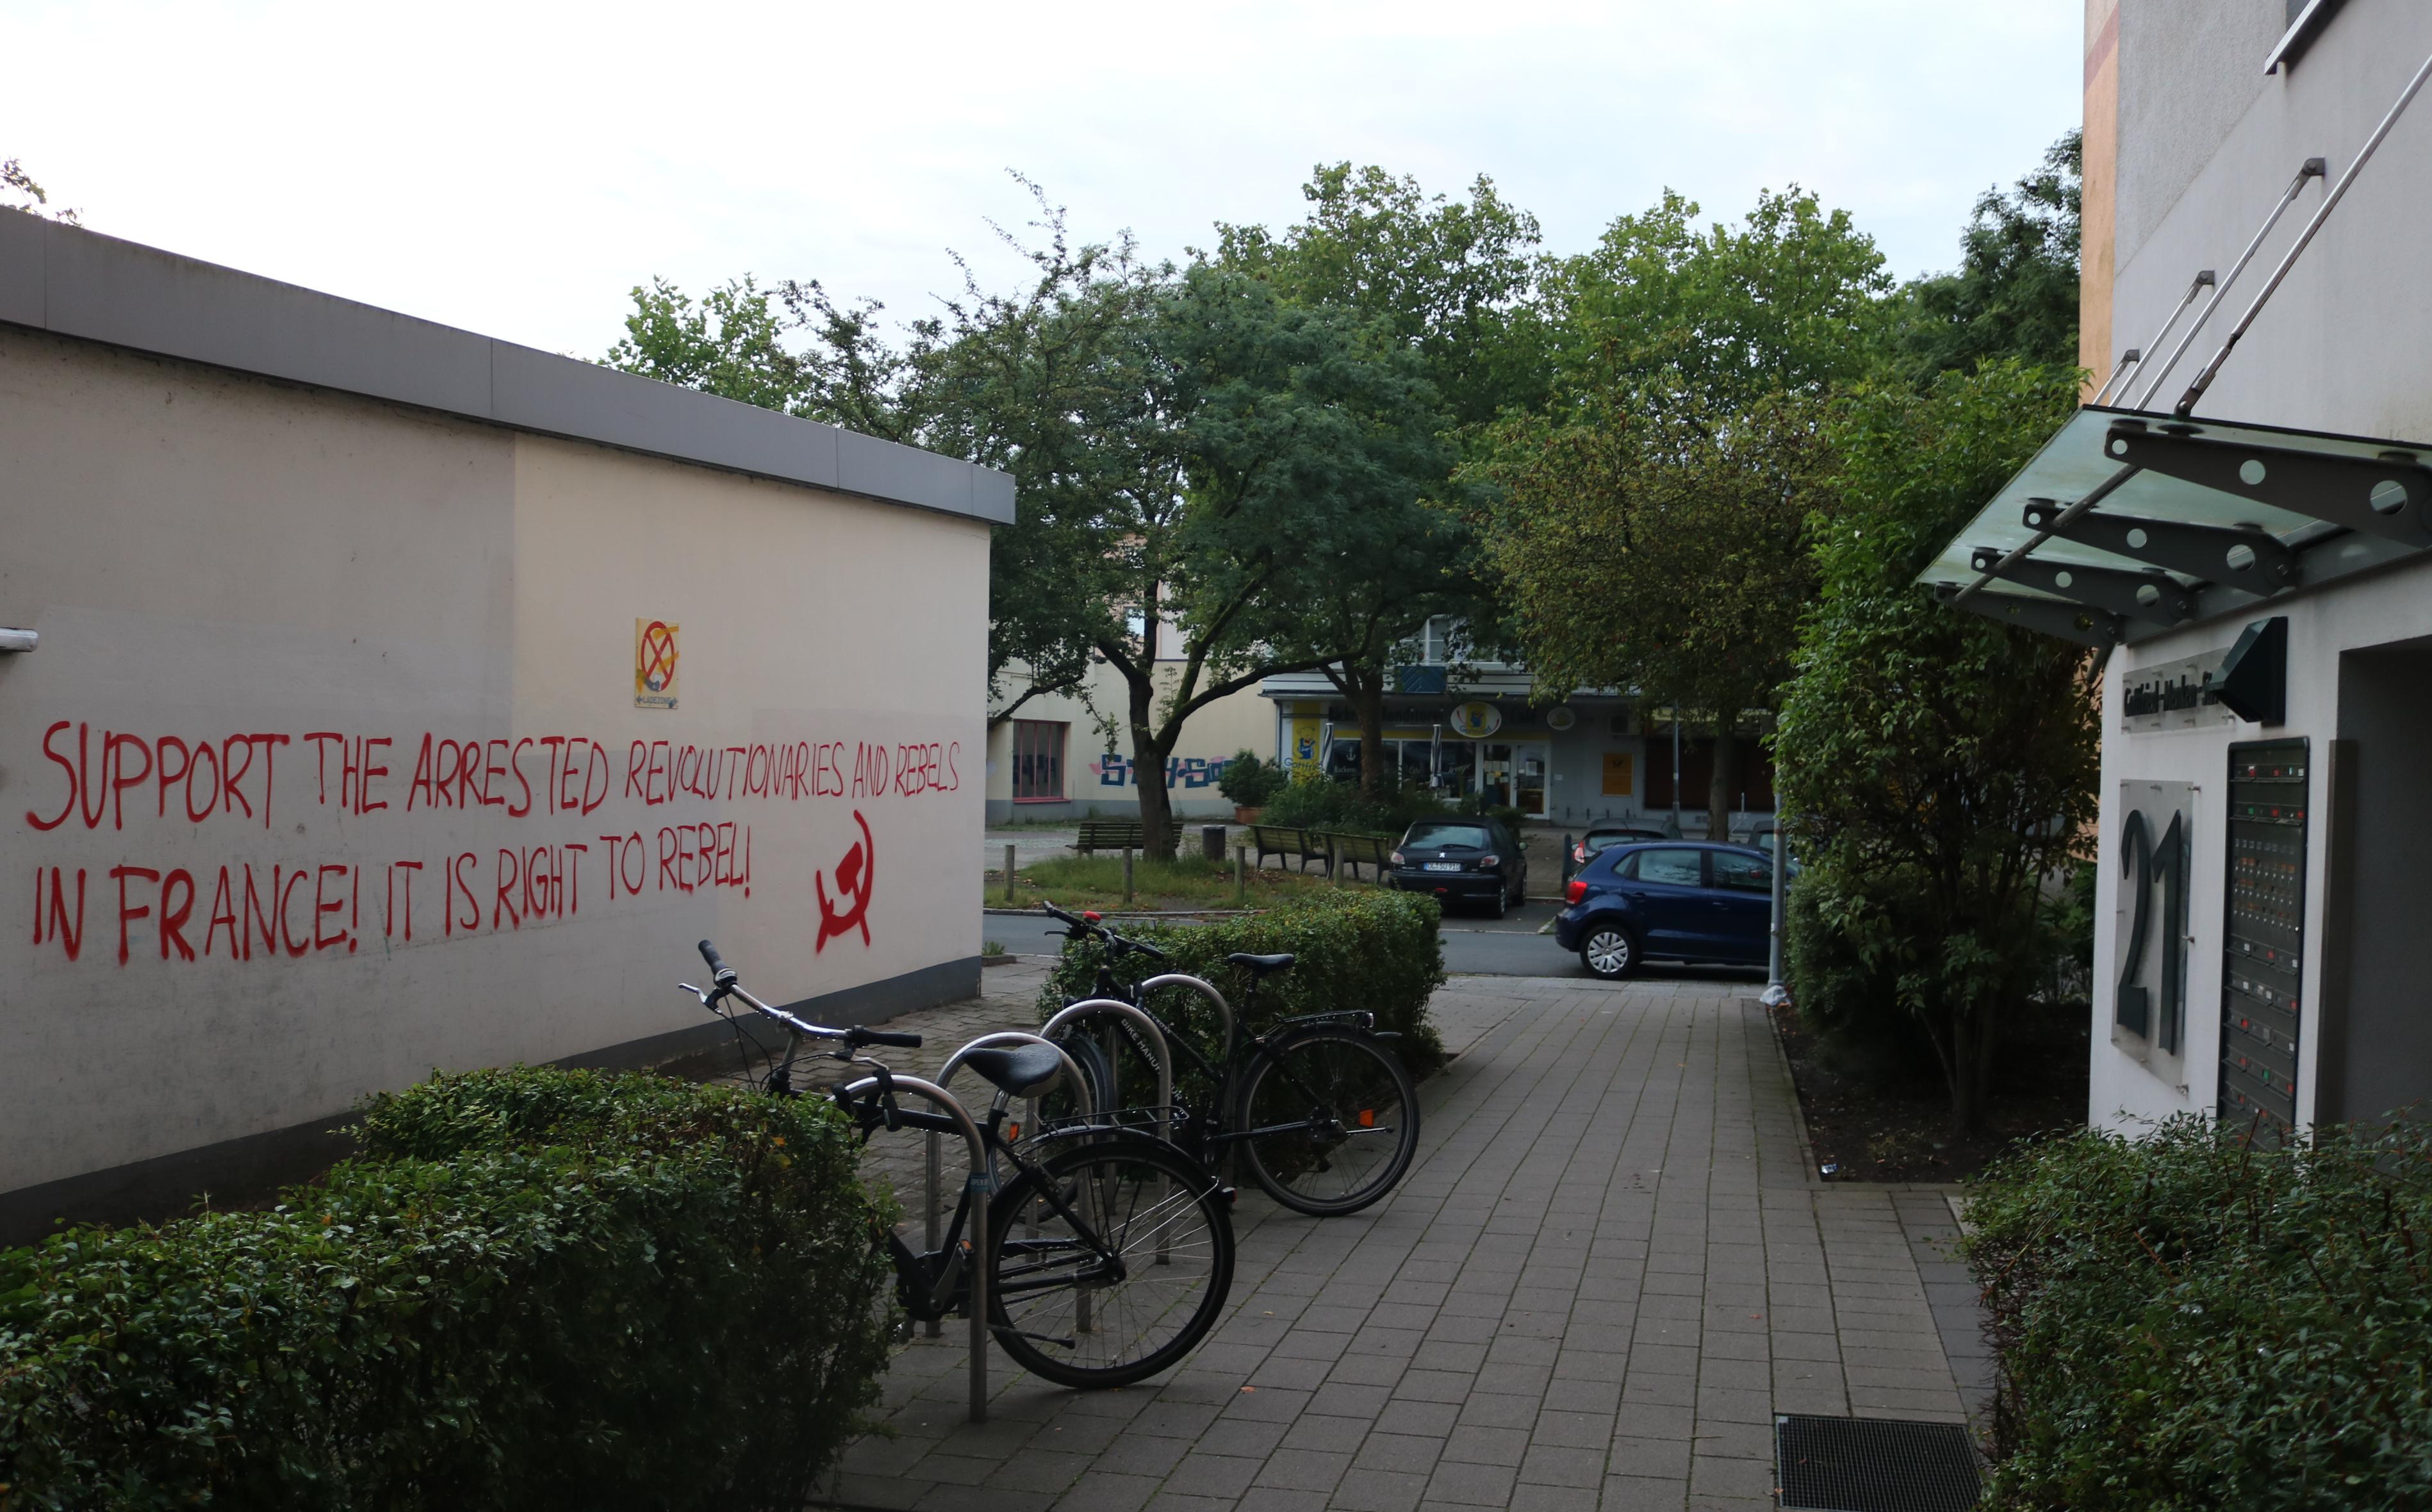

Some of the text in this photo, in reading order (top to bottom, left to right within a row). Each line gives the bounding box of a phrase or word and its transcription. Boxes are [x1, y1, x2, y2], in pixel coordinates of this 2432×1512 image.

[26, 721, 290, 830] SUPPORT
[304, 732, 392, 816] THE
[407, 732, 609, 818] ARRESTED
[625, 739, 845, 806] REVOLUTIONARIES
[852, 741, 888, 799] AND
[896, 741, 960, 798] REBELS
[33, 822, 751, 965] IN FRANCE! IT IS RIGHT TO REBEL!
[2117, 809, 2181, 1056] 21
[1121, 1018, 1139, 1042] BIKE
